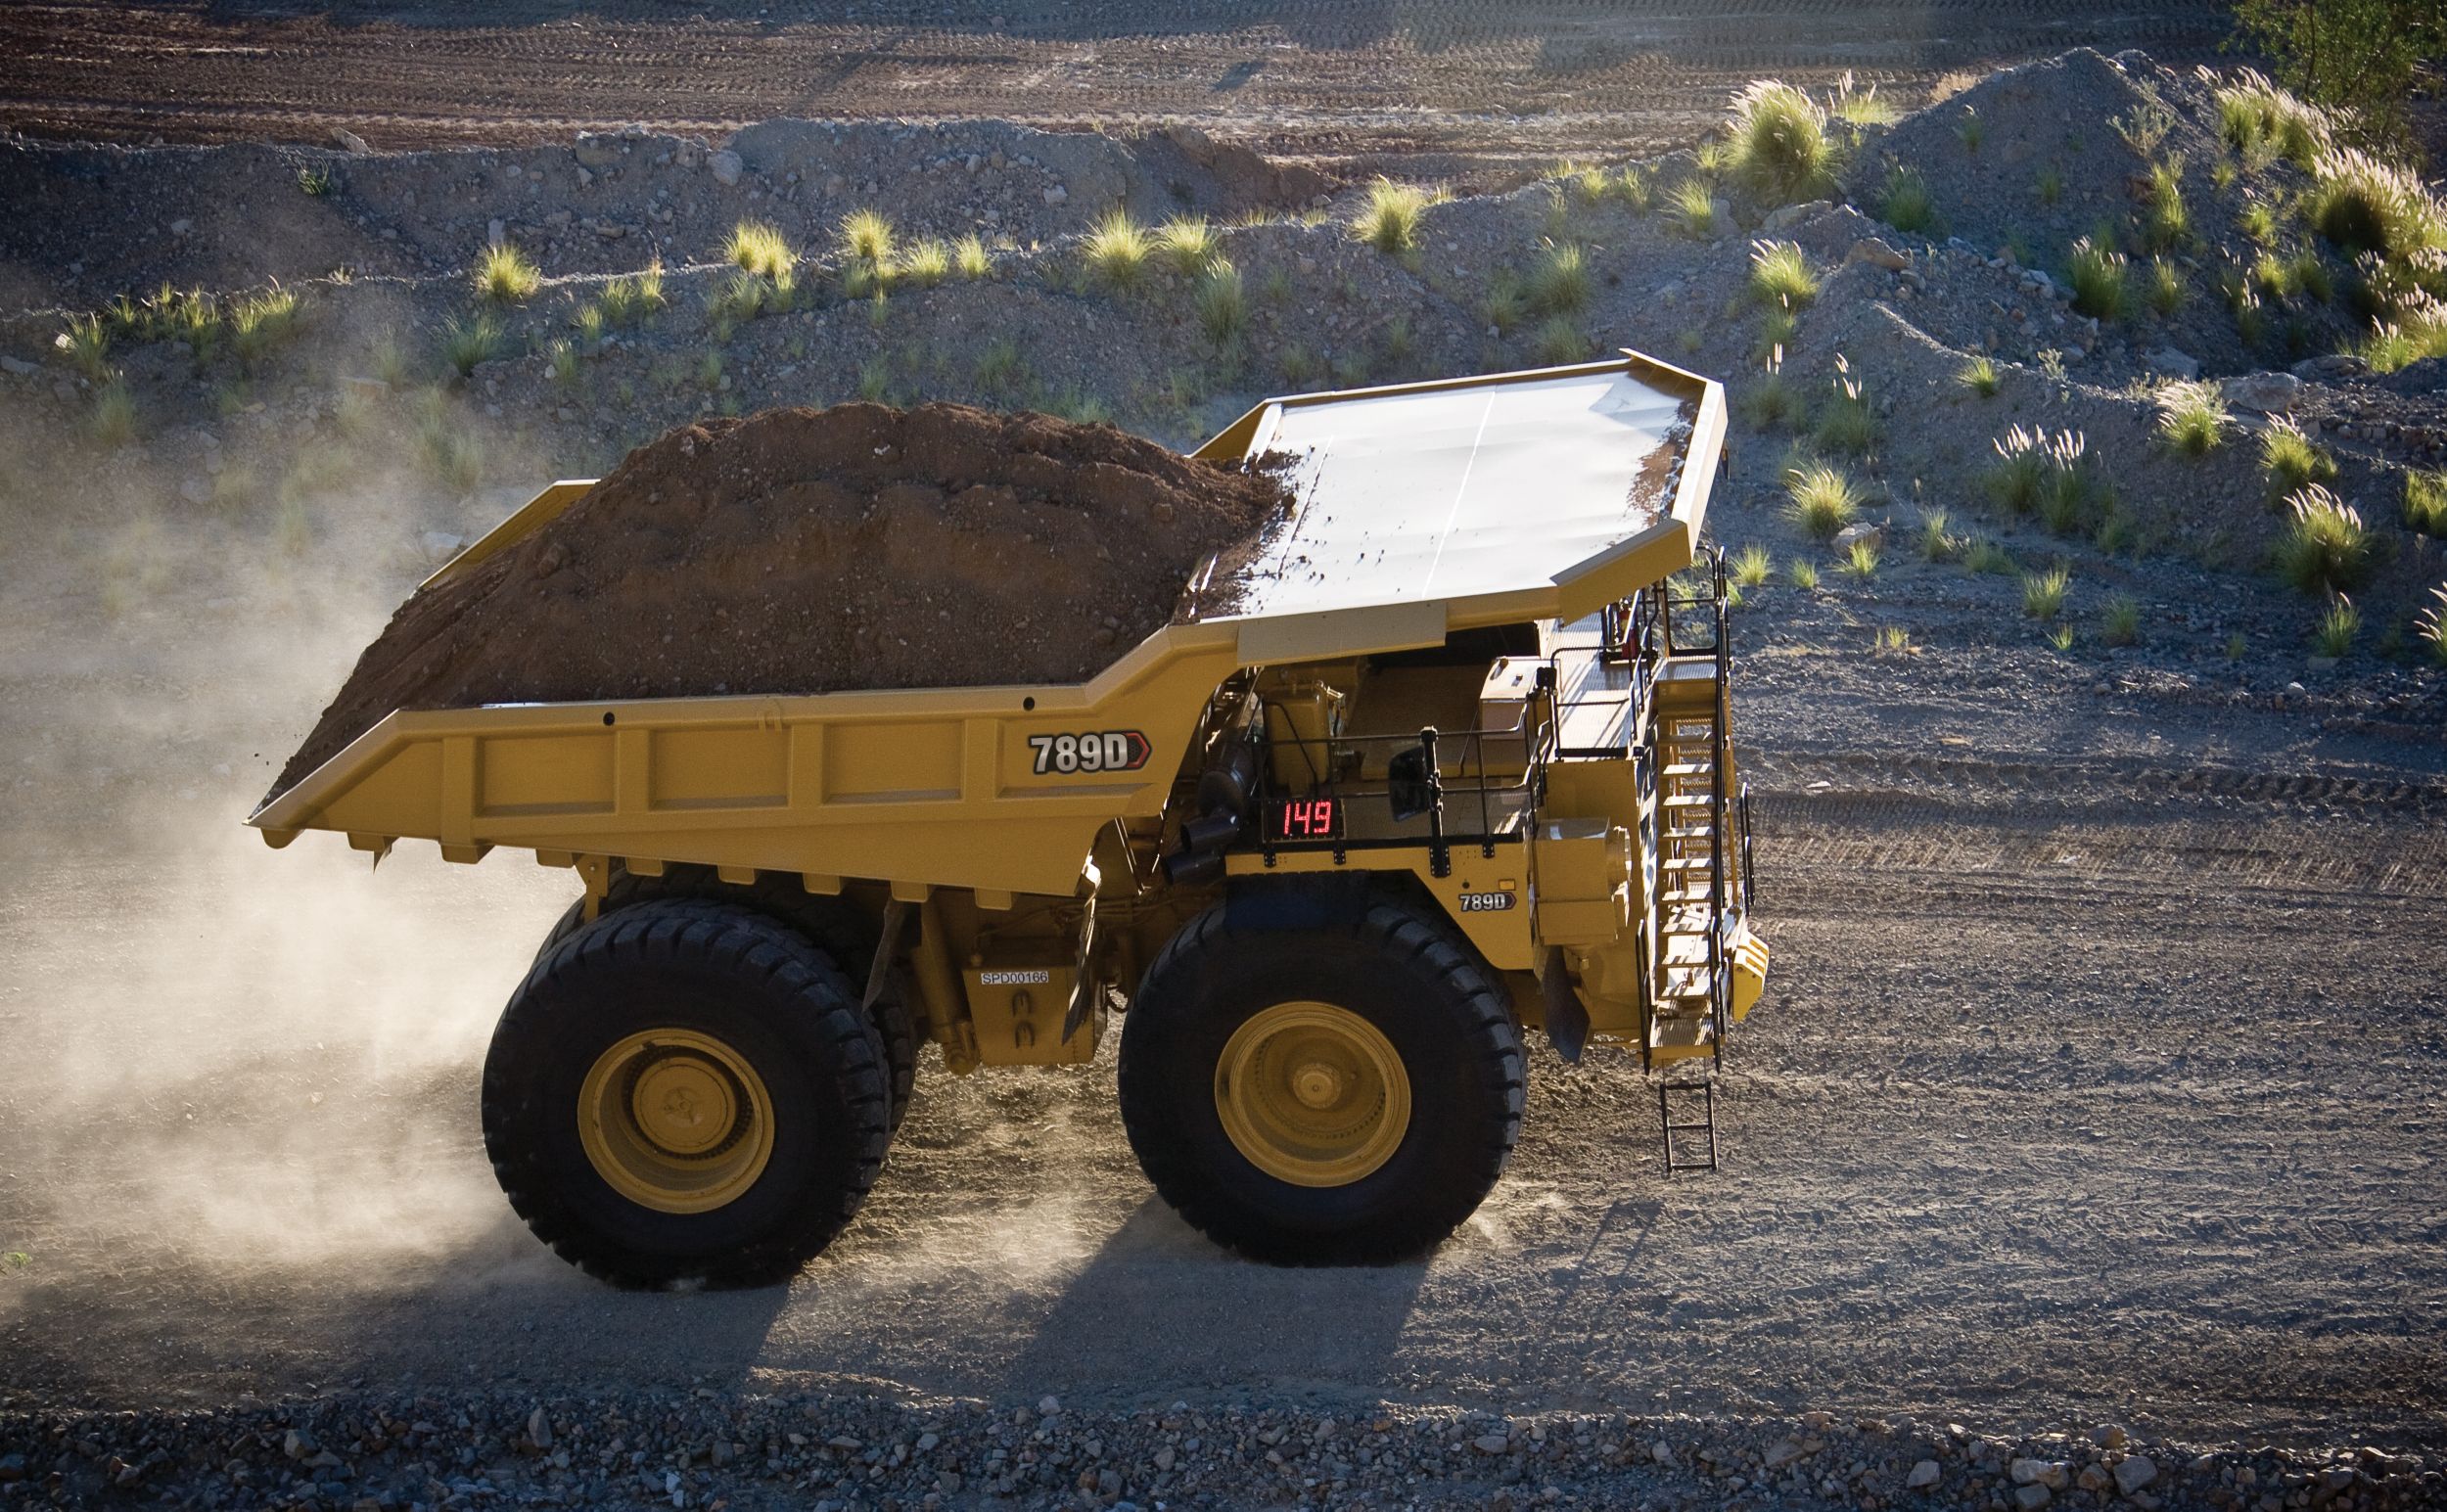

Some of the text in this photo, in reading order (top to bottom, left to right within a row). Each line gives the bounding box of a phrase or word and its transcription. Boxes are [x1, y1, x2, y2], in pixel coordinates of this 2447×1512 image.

[1031, 733, 1128, 772] 789D
[1283, 802, 1331, 835] 149
[1459, 893, 1505, 911] 789D
[982, 972, 1048, 984] SPD00166
